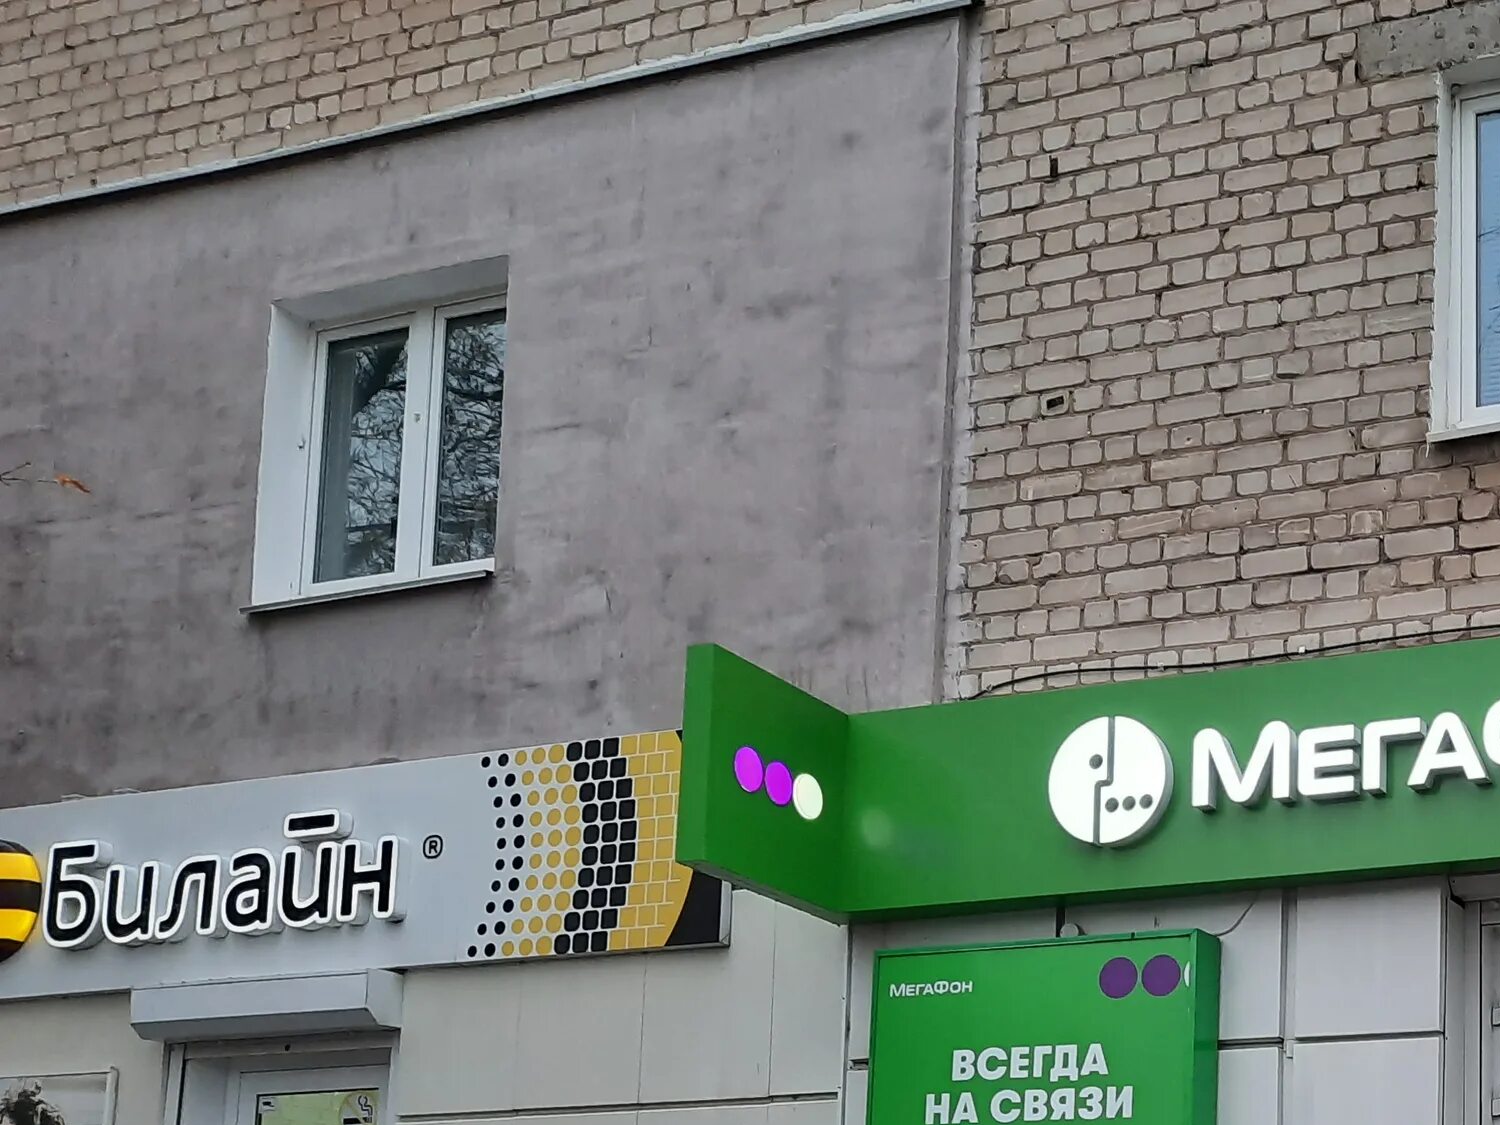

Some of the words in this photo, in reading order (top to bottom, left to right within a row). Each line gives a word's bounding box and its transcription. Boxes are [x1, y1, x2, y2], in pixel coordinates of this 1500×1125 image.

[951, 1043, 1109, 1082] ВСЕГДА
[925, 1092, 979, 1125] НА
[990, 1085, 1134, 1123] СВЯЗИ
